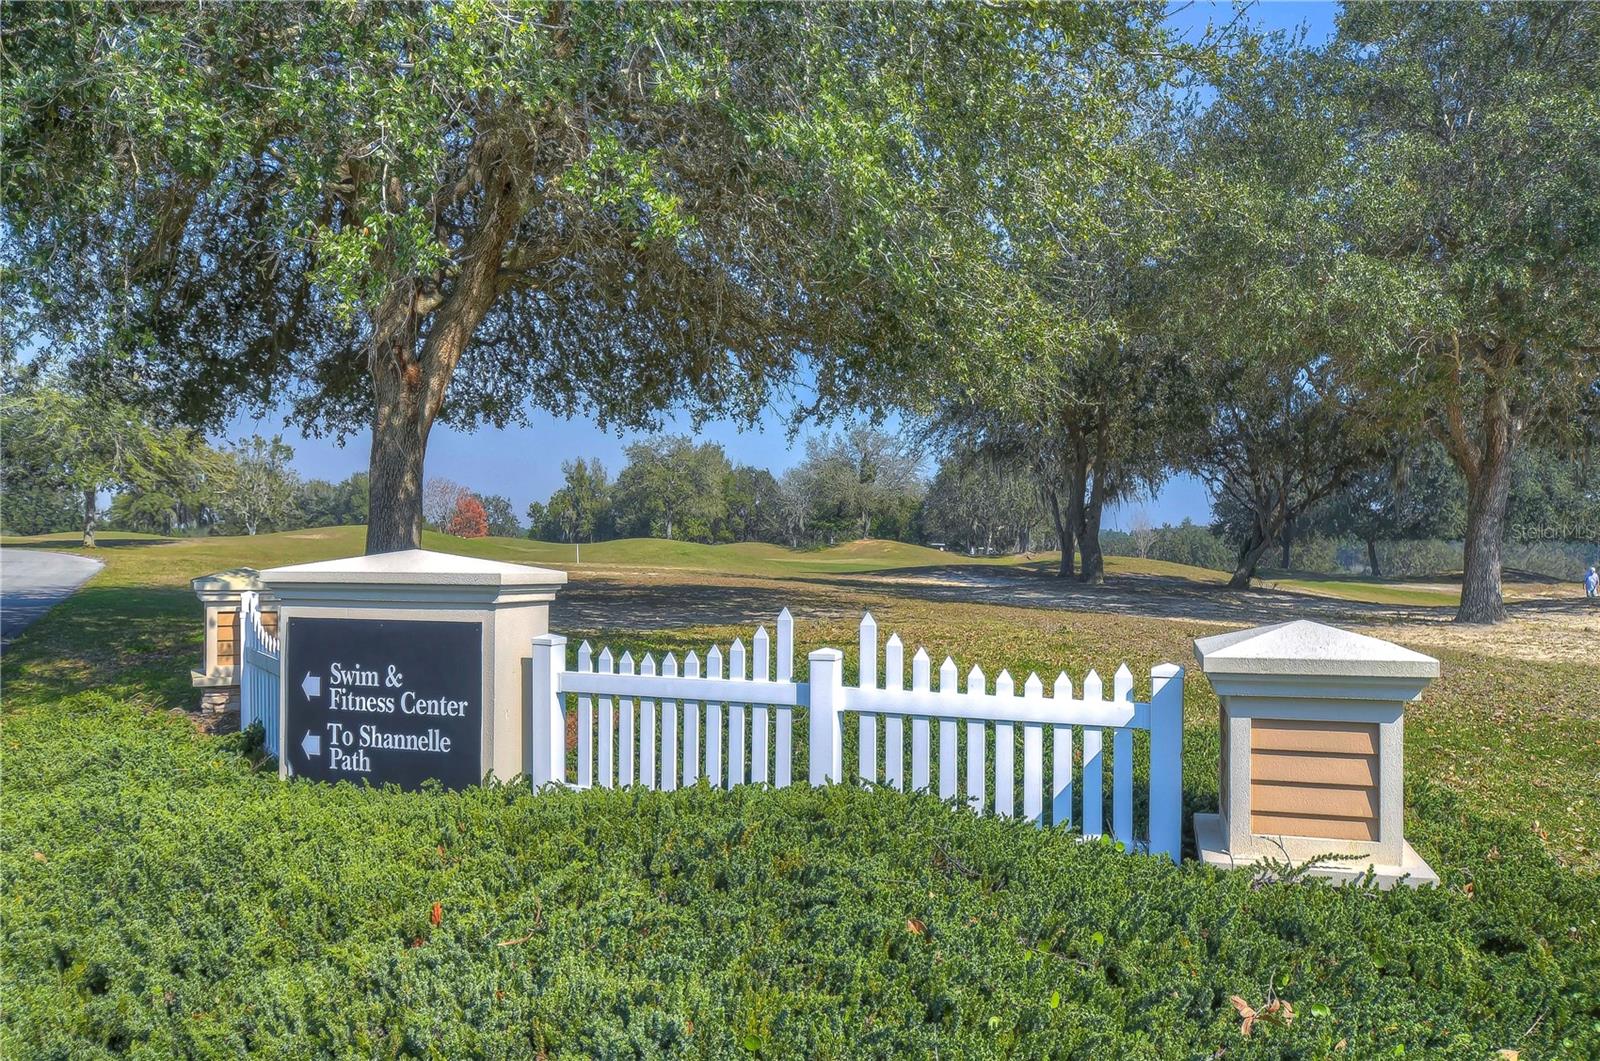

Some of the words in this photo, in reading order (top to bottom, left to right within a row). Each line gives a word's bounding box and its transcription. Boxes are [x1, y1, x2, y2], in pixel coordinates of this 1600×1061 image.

[330, 662, 379, 686] Swim
[385, 664, 403, 688] &
[329, 687, 395, 713] Fitness
[400, 691, 468, 716] Center
[327, 722, 353, 746] To
[359, 724, 451, 752] Shannelle
[329, 748, 371, 772] Path
